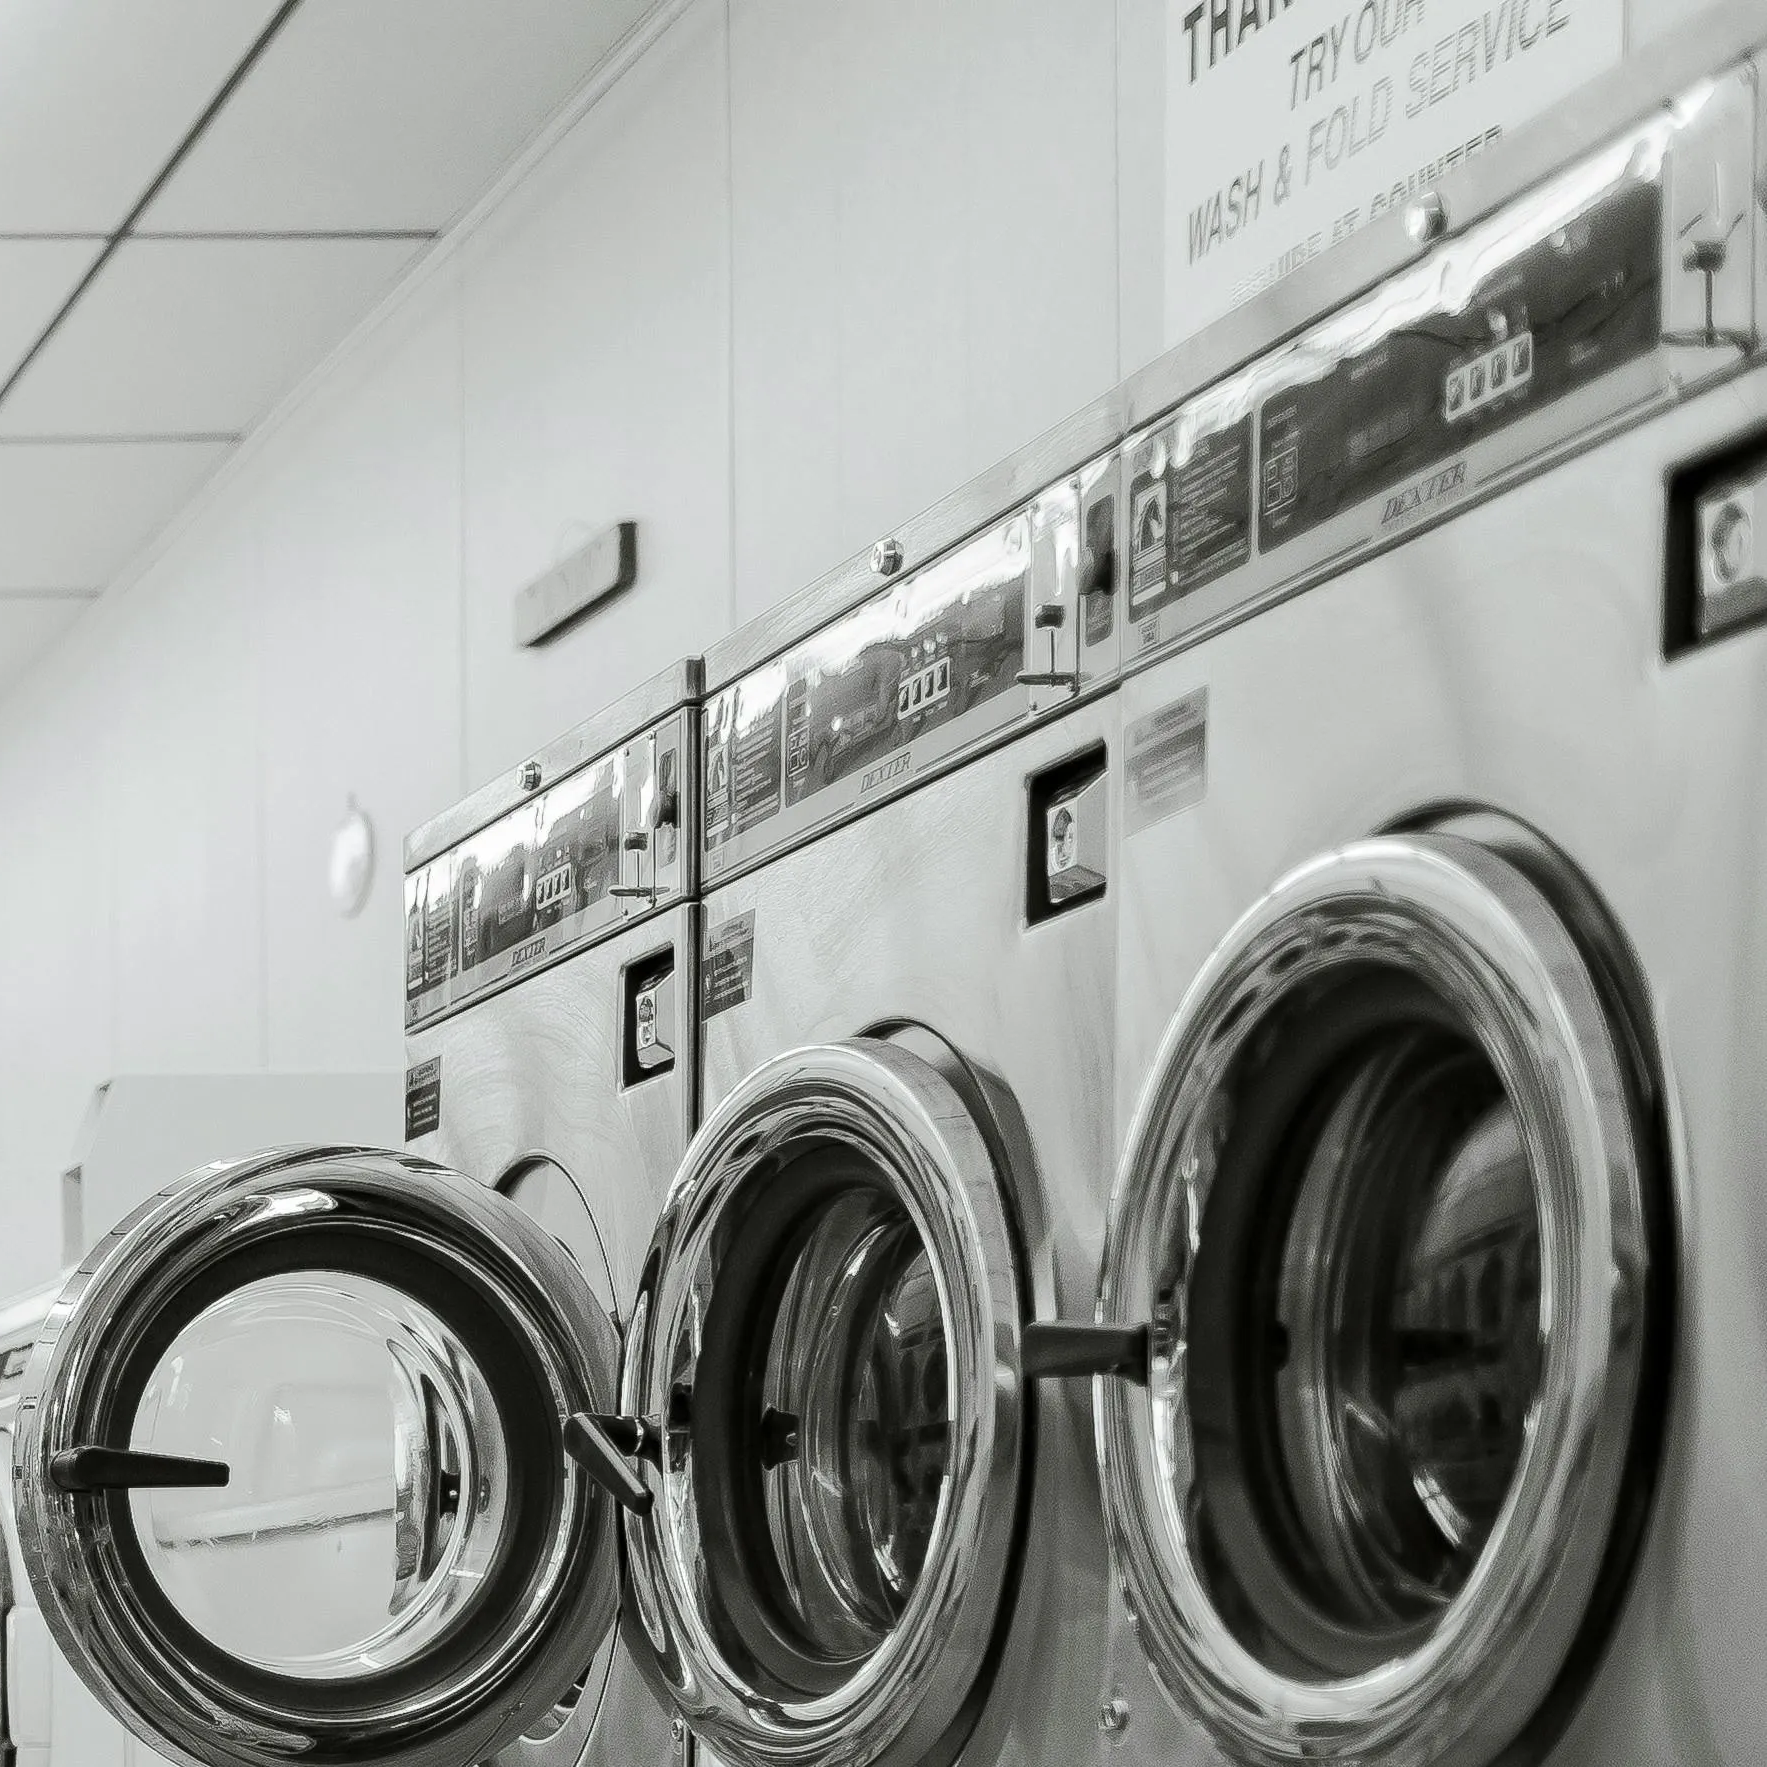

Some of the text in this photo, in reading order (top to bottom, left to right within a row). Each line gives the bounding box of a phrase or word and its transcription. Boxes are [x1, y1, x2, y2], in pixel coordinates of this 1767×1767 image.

[1183, 0, 1294, 84] THA
[1289, 14, 1351, 110] TRY
[1188, 160, 1265, 266] WASH
[1273, 143, 1294, 206] &
[1304, 74, 1395, 187] FOLD
